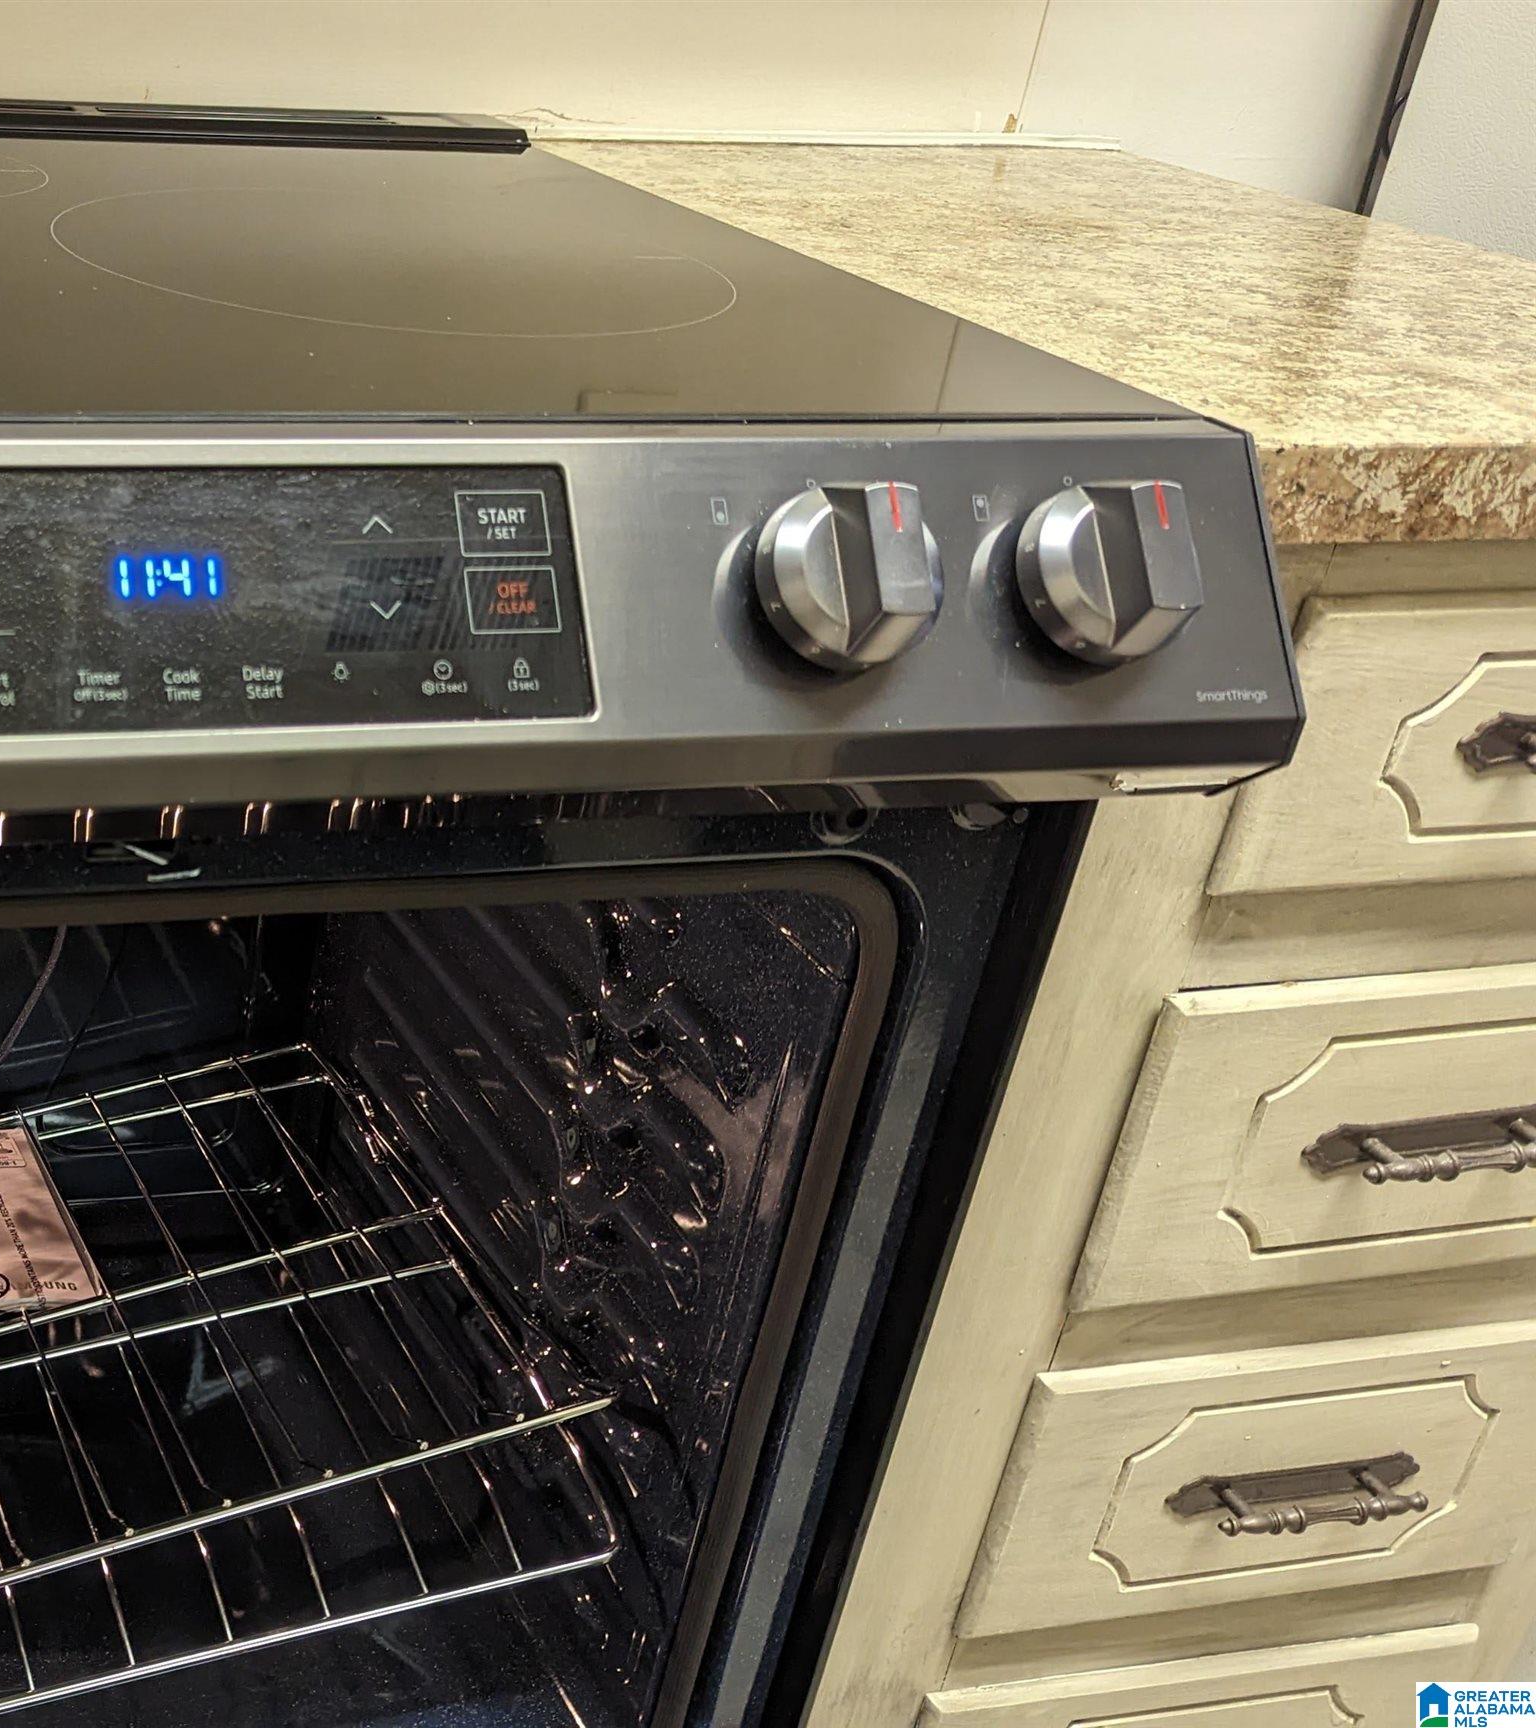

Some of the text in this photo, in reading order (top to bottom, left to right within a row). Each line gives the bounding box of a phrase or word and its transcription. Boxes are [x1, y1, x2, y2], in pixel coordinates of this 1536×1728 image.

[477, 508, 526, 525] START
[487, 526, 516, 541] /SET
[119, 558, 218, 598] 11:41
[497, 581, 528, 599] OFF
[76, 669, 121, 686] Timer
[163, 666, 200, 684] Cook
[242, 665, 284, 683] Delay
[165, 686, 202, 702] Time
[246, 683, 284, 700] Start
[1196, 689, 1269, 704] SmartThings
